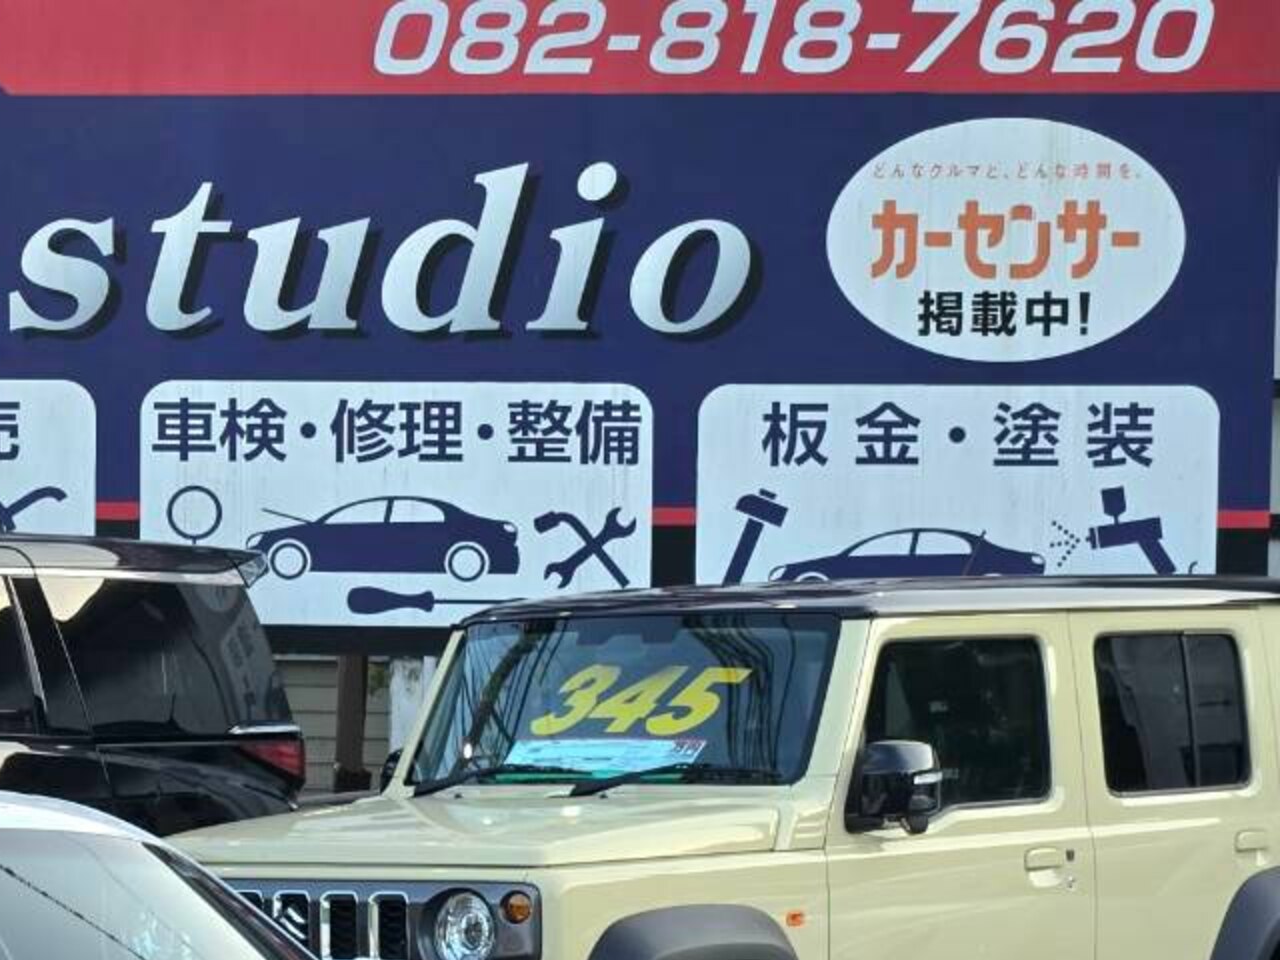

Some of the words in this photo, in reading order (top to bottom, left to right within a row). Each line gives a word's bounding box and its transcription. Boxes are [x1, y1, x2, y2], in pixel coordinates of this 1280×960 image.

[374, 0, 1214, 75] 082-818-7620
[8, 162, 751, 333] studio
[870, 200, 1140, 280] カーセンサー
[151, 399, 643, 466] 車検・修理・整備
[761, 401, 1156, 469] 板金・塗装
[530, 664, 752, 736] 345
